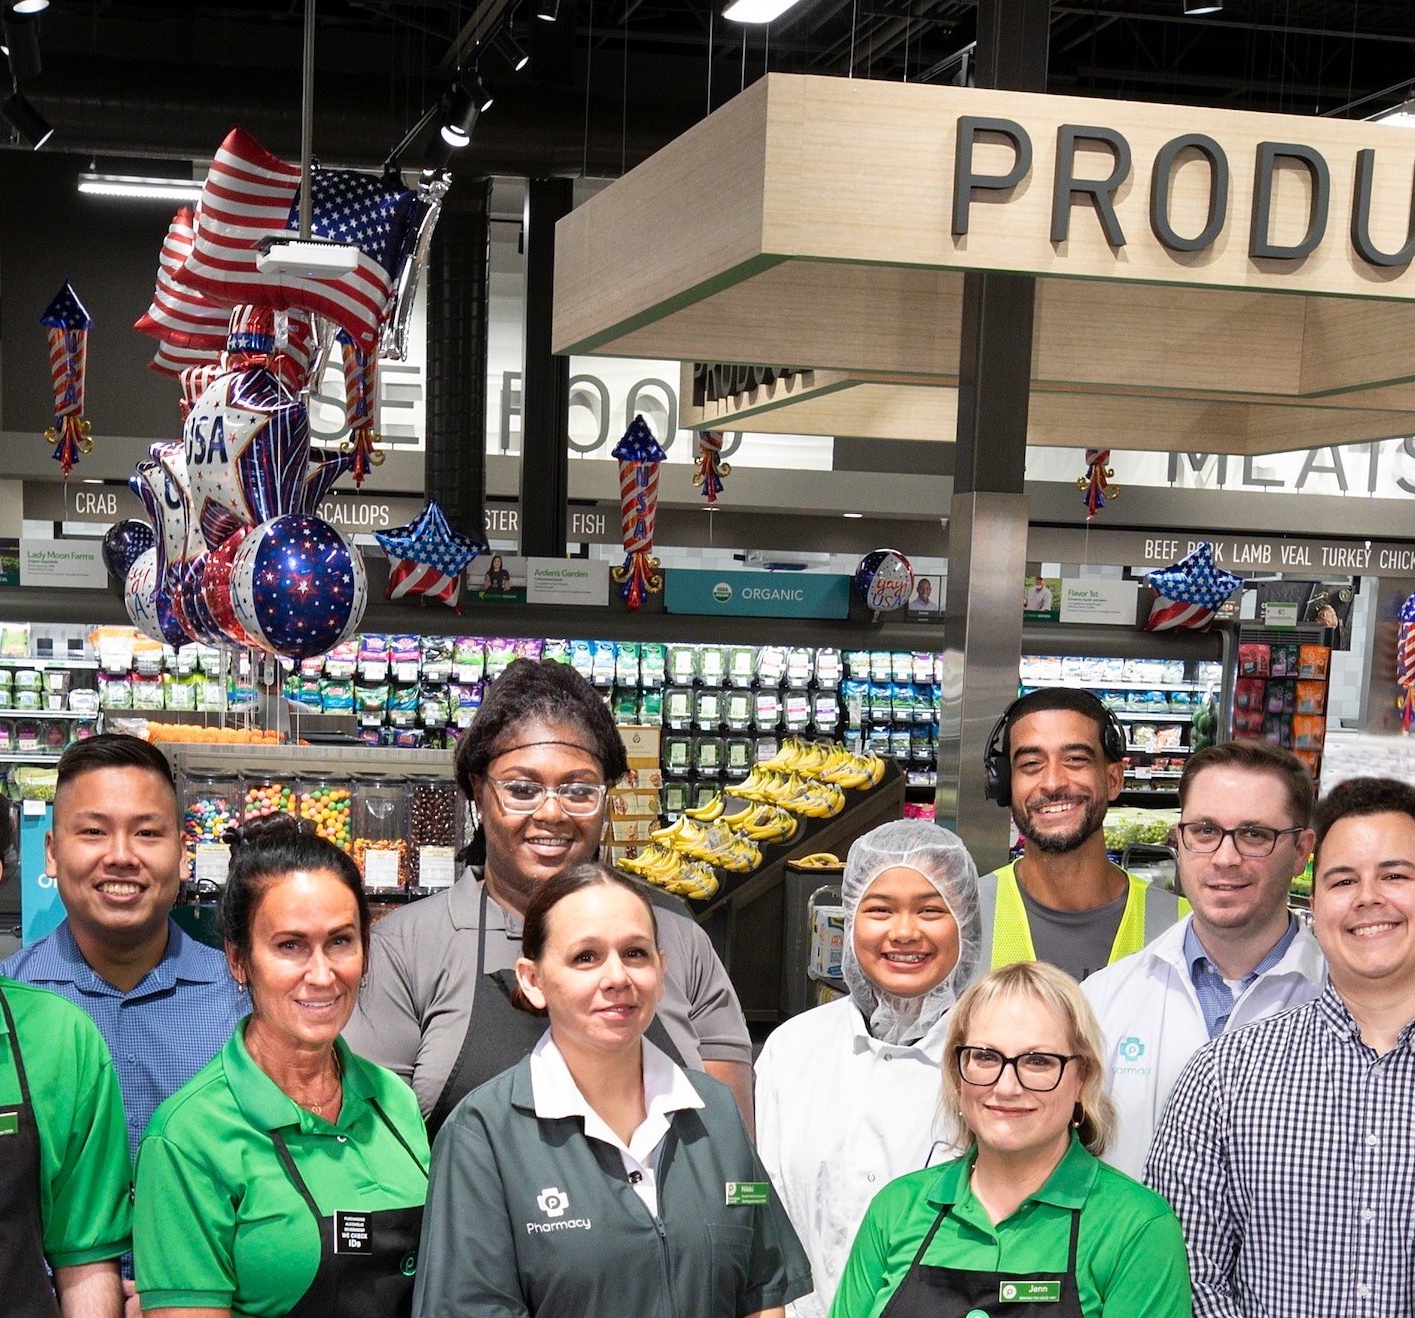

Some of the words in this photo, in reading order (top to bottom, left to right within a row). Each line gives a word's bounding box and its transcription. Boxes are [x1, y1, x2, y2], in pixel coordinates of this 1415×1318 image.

[62, 329, 77, 405] USA
[184, 415, 228, 466] USA
[75, 492, 118, 515] CRAB
[633, 465, 648, 541] USA
[316, 502, 389, 526] SCALLOPS
[484, 509, 518, 531] STER
[572, 513, 606, 534] FISH
[28, 551, 46, 560] Lady
[47, 551, 71, 560] Moon
[71, 552, 94, 561] Farms
[1145, 540, 1178, 559] BEEF
[1188, 542, 1224, 563] POK
[1233, 543, 1271, 564] LAMB
[1281, 545, 1312, 566] VEAL
[1322, 547, 1373, 568] TURKEY
[534, 568, 560, 578] Arden's
[561, 569, 588, 578] Garden
[741, 587, 804, 601] ORGANIC
[872, 593, 903, 607] USA
[1068, 589, 1088, 598] Flavor
[1089, 589, 1099, 598] 1st
[526, 1218, 592, 1235] Pharmacy
[348, 1239, 361, 1248] IDs
[1028, 1285, 1048, 1293] Jenn
